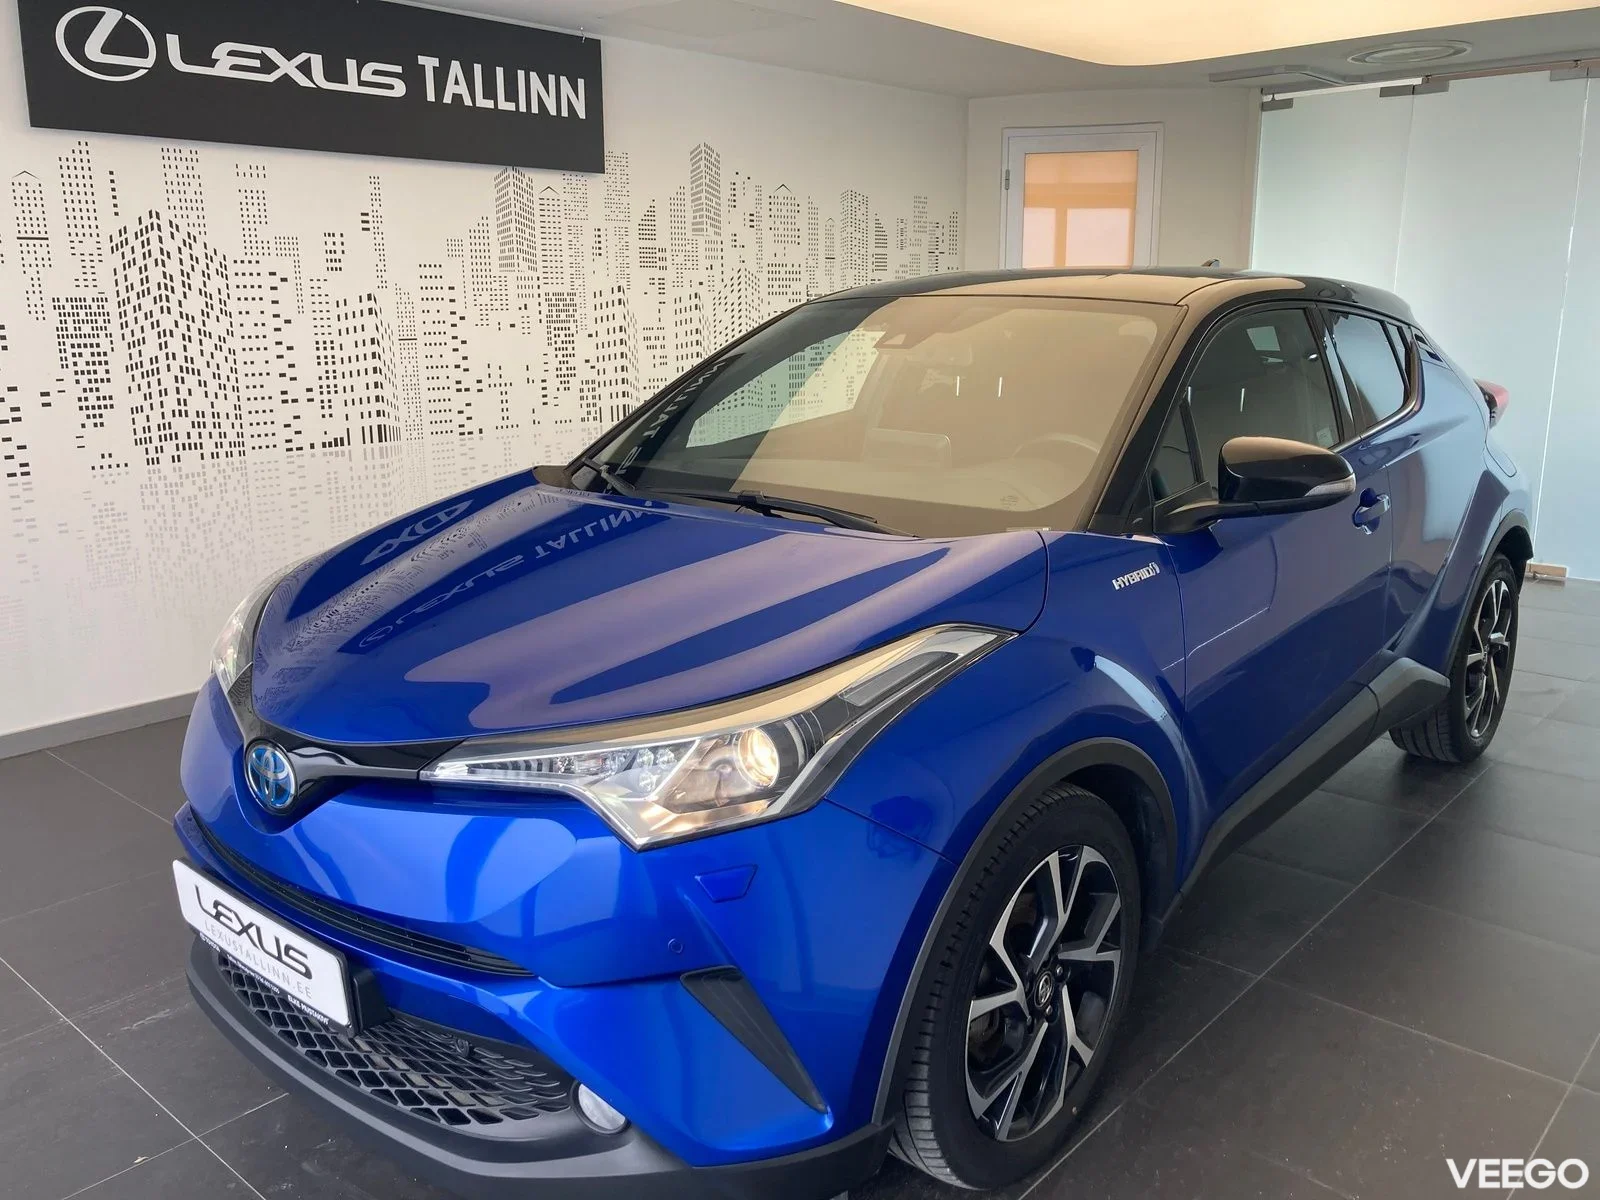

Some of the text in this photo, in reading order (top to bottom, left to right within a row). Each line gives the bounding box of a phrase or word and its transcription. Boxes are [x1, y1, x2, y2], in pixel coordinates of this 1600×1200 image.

[166, 33, 586, 120] LEXUS TALLINN
[1112, 565, 1155, 591] HYBRID
[194, 884, 313, 980] LEXUS
[204, 919, 313, 1000] LEXUSTALLINN.EE
